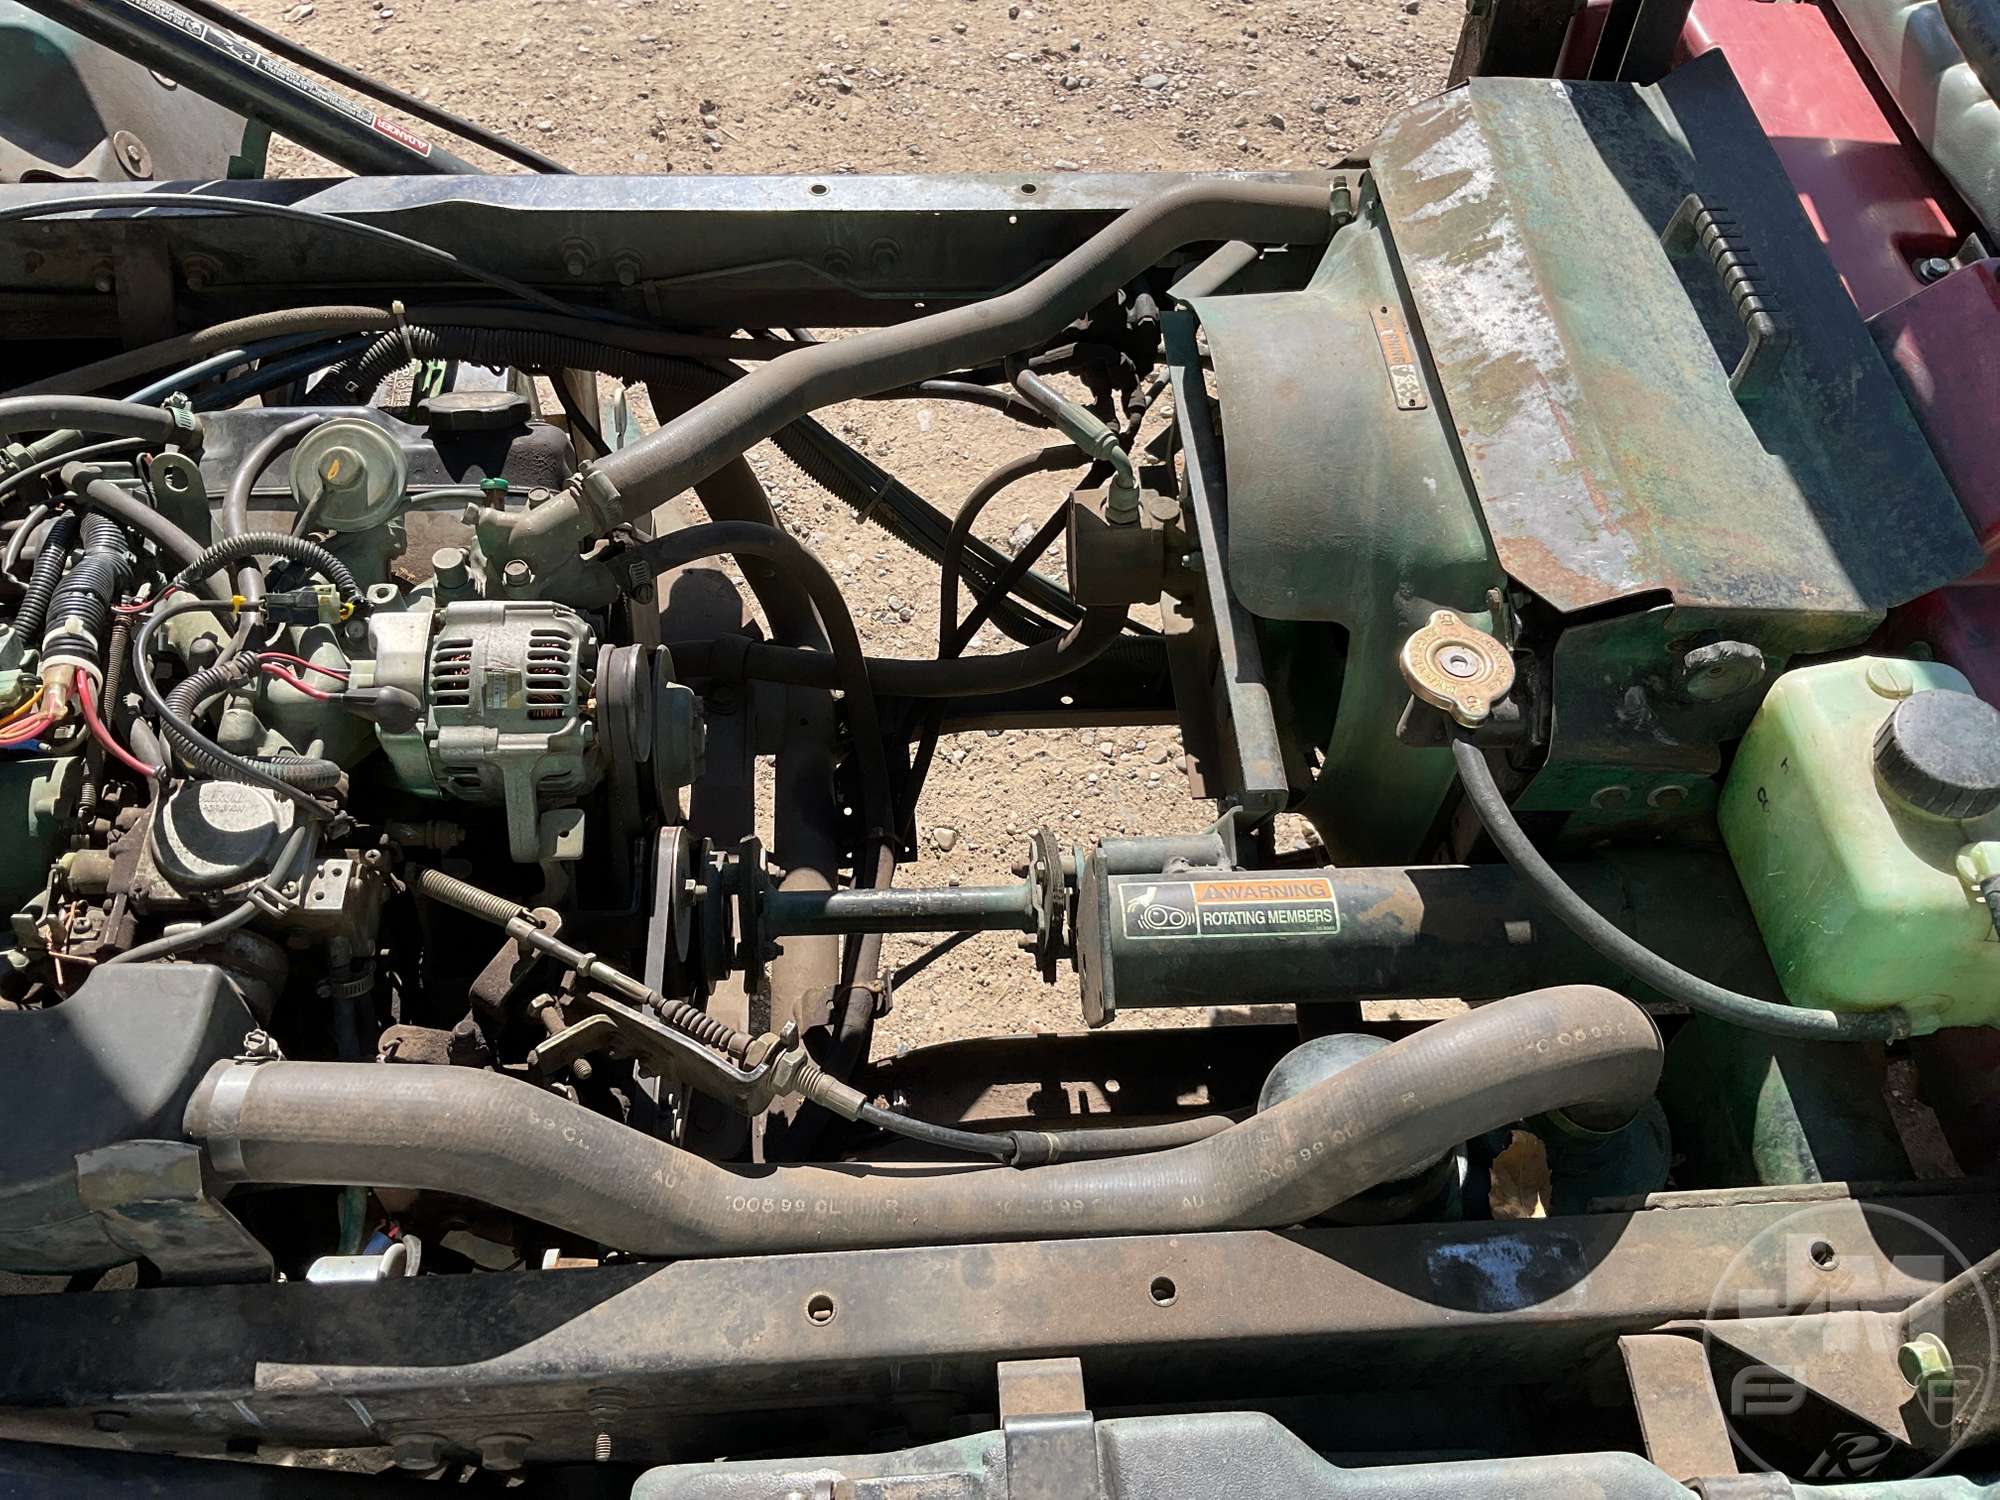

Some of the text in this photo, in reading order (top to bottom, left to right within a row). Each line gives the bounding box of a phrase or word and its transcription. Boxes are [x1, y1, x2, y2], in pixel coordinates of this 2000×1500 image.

[377, 119, 420, 146] DANGER
[1222, 884, 1325, 901] WARNING
[1203, 908, 1333, 926] ROTATING MEMBERS
